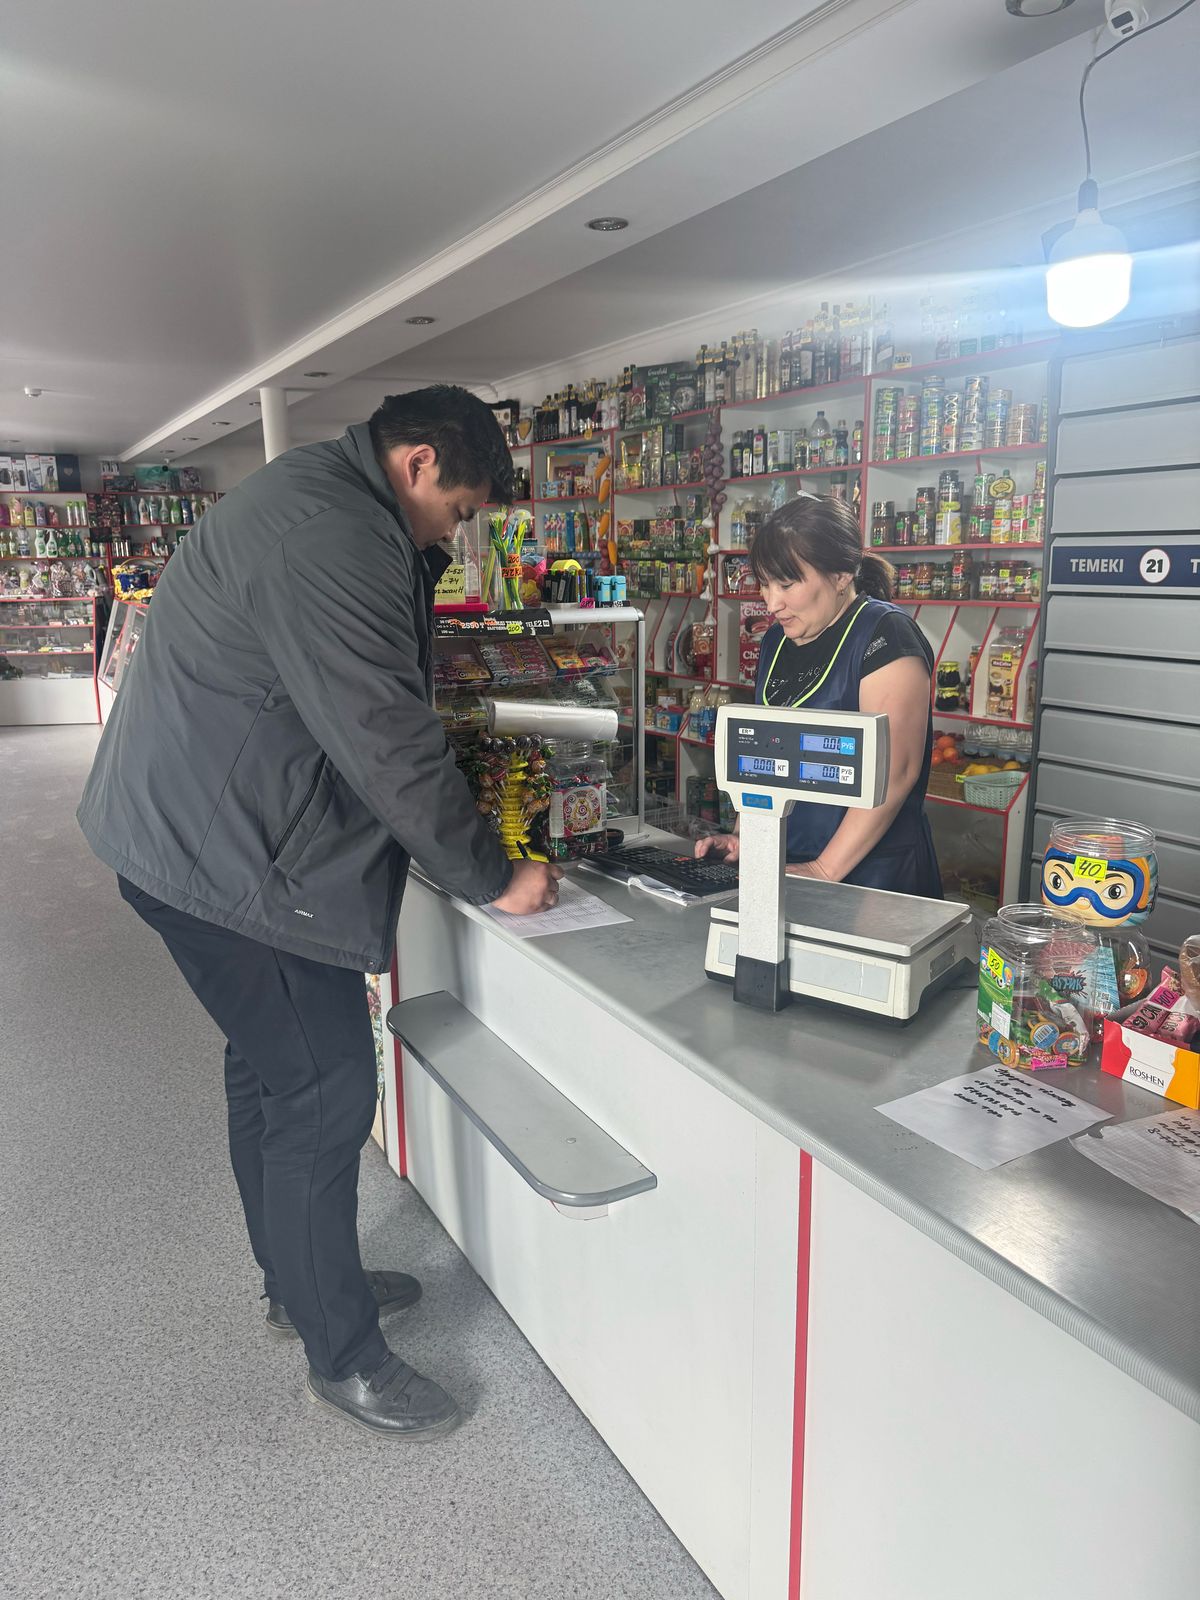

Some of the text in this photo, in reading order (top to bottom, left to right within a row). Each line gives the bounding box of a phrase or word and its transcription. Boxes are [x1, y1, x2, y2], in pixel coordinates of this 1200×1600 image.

[1070, 558, 1124, 573] TEMEKI
[1145, 559, 1163, 573] 21
[841, 742, 854, 750] РУБ
[777, 764, 787, 772] КГ
[841, 768, 853, 776] РУБ
[1079, 859, 1102, 878] 40
[1129, 1066, 1165, 1087] ROSHEN
